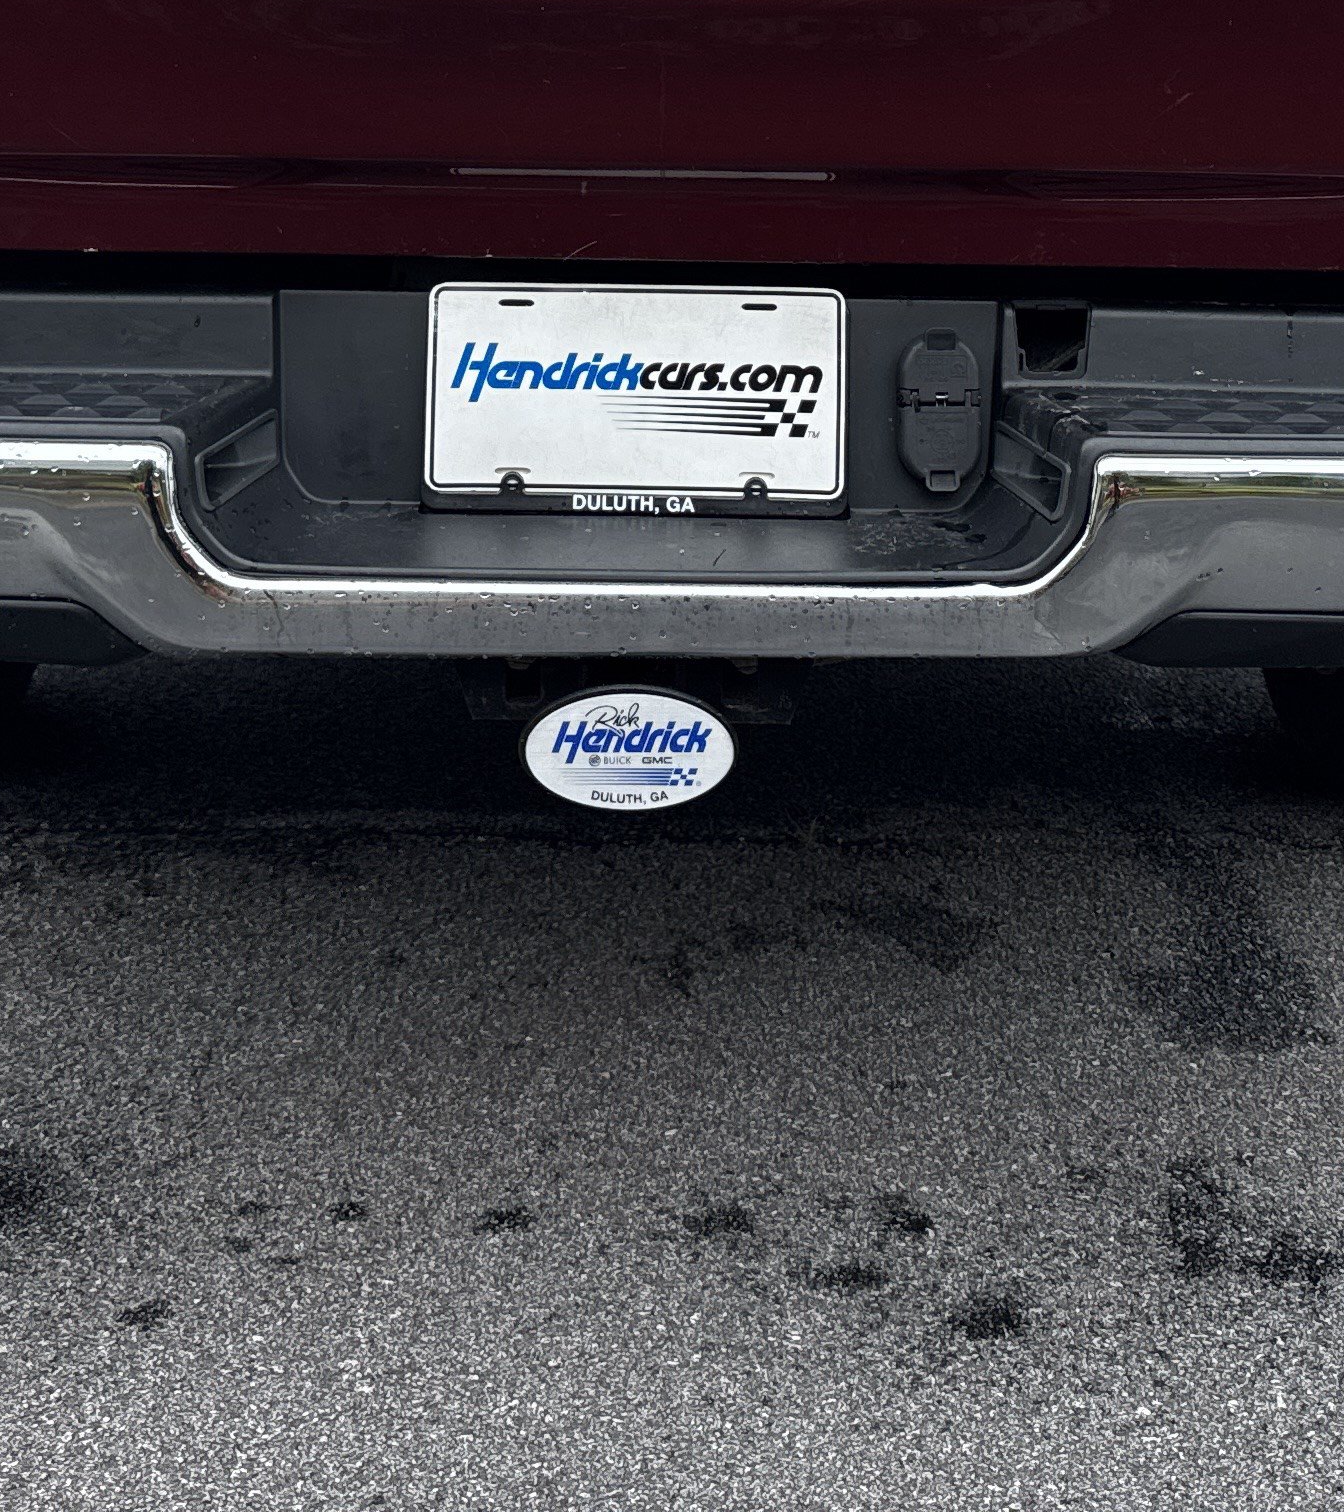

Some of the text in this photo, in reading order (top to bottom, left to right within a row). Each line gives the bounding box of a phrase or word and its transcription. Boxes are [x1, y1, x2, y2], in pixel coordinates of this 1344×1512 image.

[450, 341, 824, 403] Hendrickcars.com
[572, 493, 696, 515] DULUTH, GA
[585, 702, 640, 734] Rick
[551, 720, 713, 765] Hendrick
[603, 755, 674, 765] BUICK GMC
[590, 789, 670, 806] DULUTH, GA
